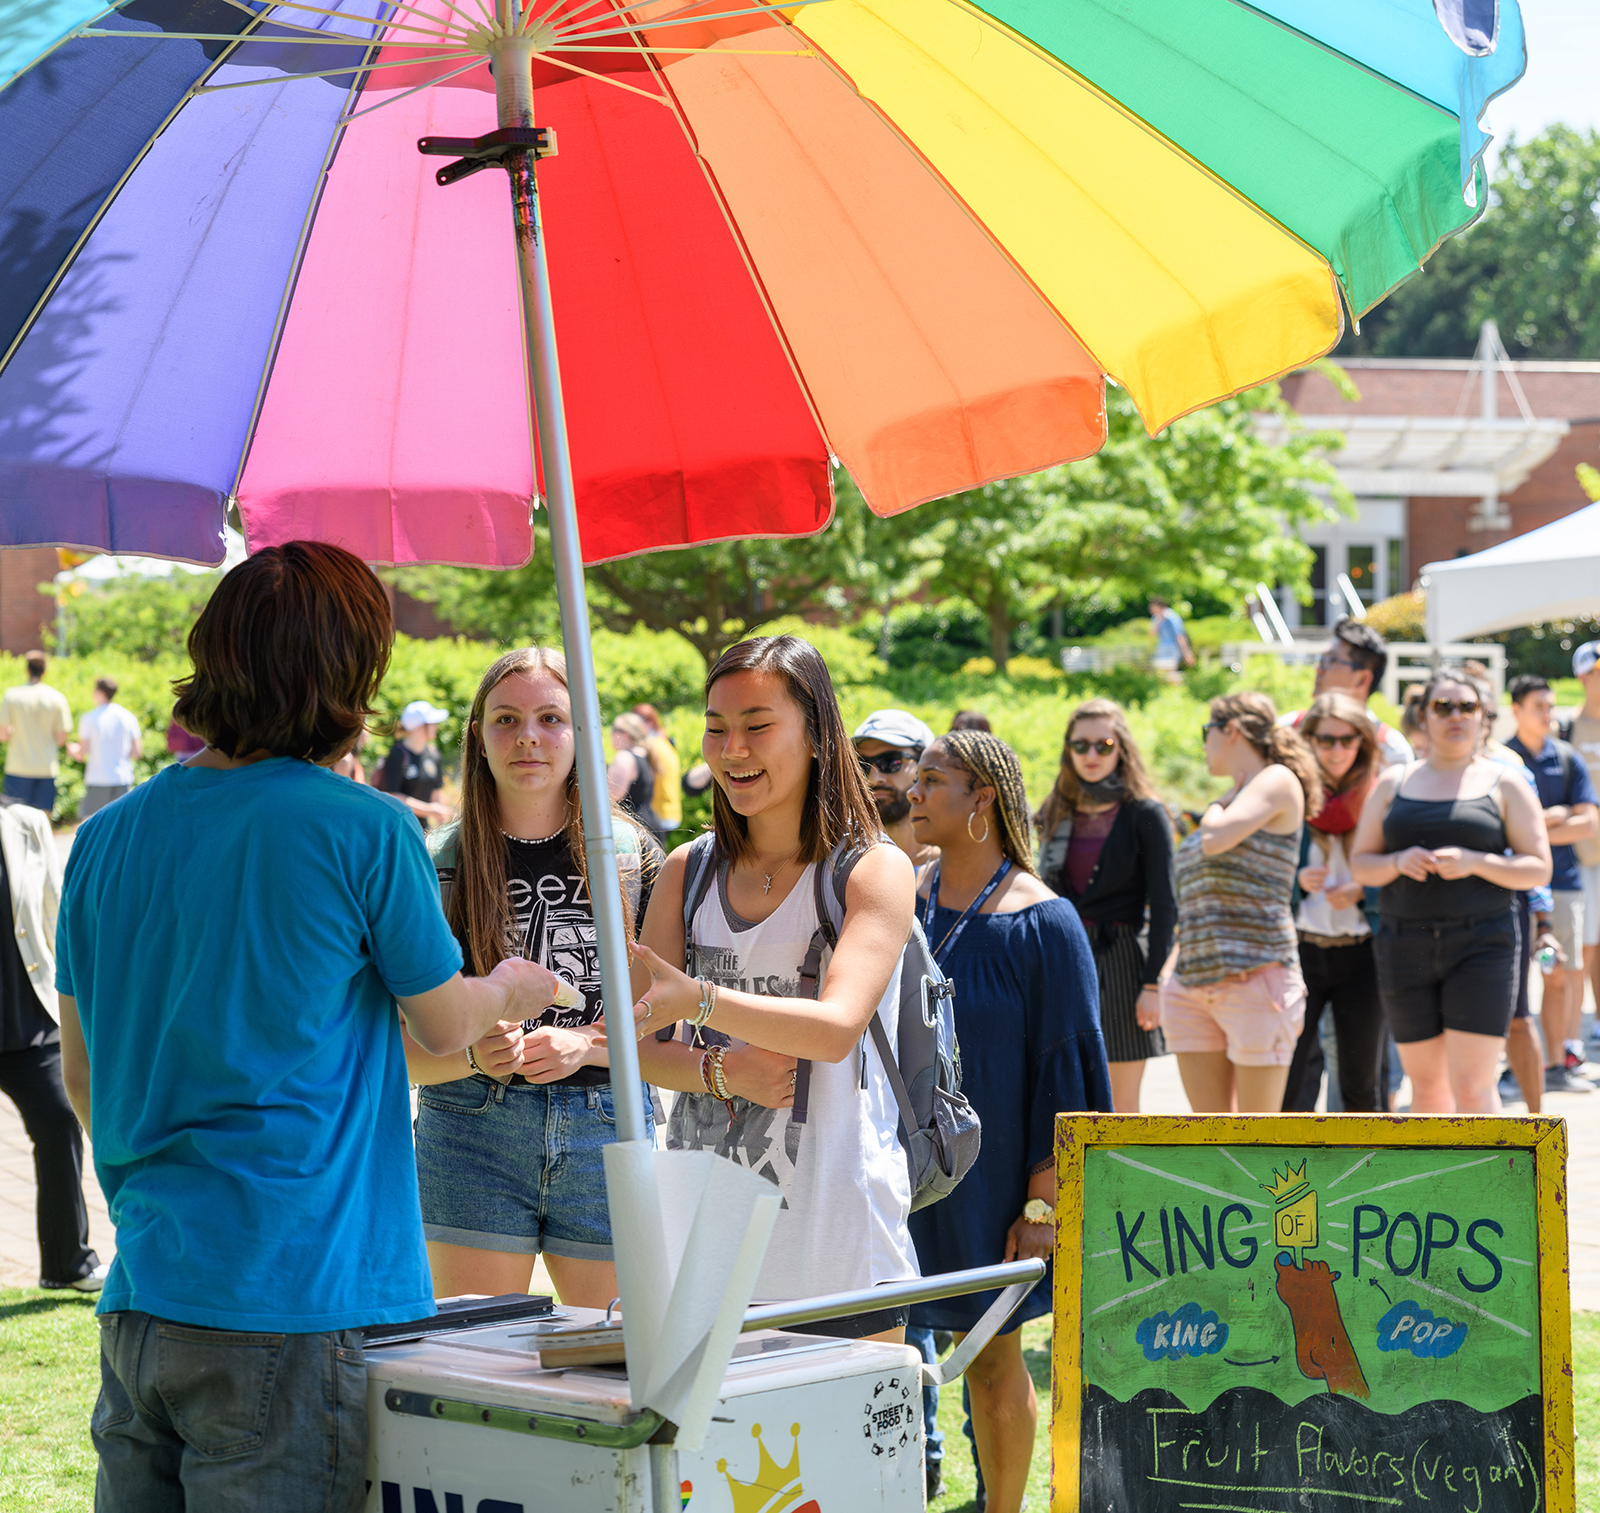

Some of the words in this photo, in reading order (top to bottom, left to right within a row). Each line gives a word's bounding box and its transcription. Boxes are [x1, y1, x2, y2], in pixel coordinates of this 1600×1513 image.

[506, 874, 592, 907] eez
[715, 953, 739, 971] THE
[1115, 1203, 1259, 1283] KING
[1281, 1213, 1307, 1237] OF
[1352, 1203, 1504, 1294] POPS
[1152, 1319, 1219, 1349] KING
[1389, 1313, 1454, 1344] POP
[872, 1403, 904, 1422] STREET
[877, 1415, 900, 1431] FOOD
[1146, 1407, 1269, 1477] Fruit
